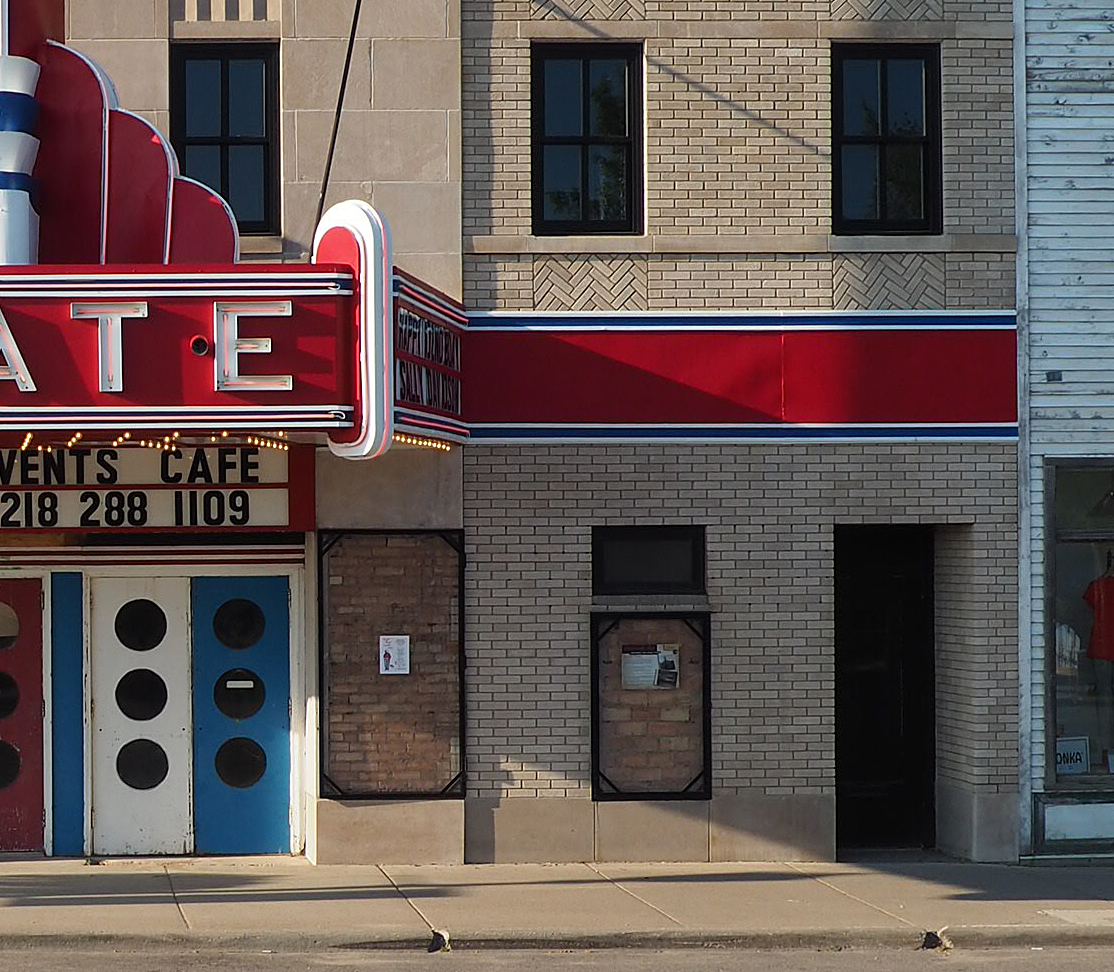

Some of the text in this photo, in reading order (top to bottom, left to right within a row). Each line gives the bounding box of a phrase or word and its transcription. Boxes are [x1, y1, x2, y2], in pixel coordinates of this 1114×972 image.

[161, 447, 259, 484] CAFE
[0, 491, 58, 528] 218
[80, 491, 148, 527] 288
[175, 489, 250, 526] 1109
